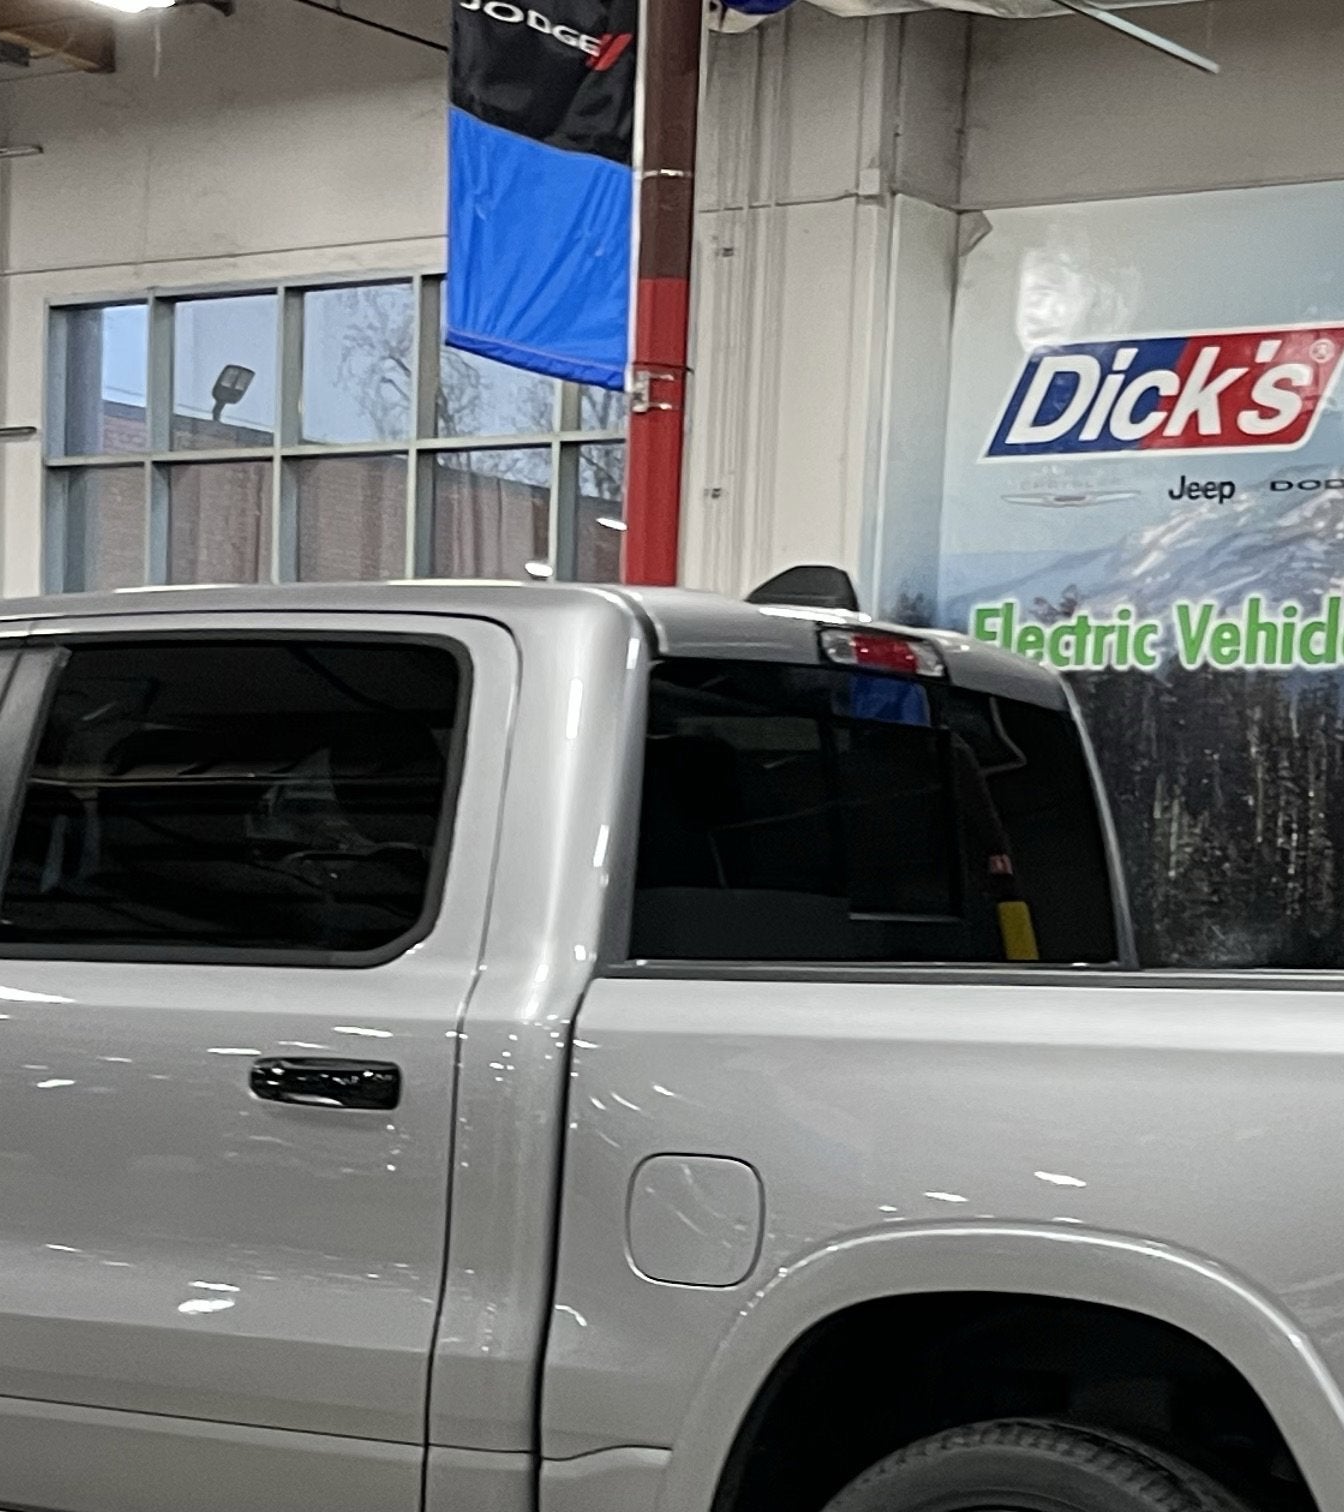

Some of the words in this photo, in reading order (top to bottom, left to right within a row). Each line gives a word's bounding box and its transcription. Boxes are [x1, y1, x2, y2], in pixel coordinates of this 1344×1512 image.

[1005, 339, 1314, 445] Dick's
[1168, 475, 1236, 503] Jeep
[975, 602, 1159, 667] Electric
